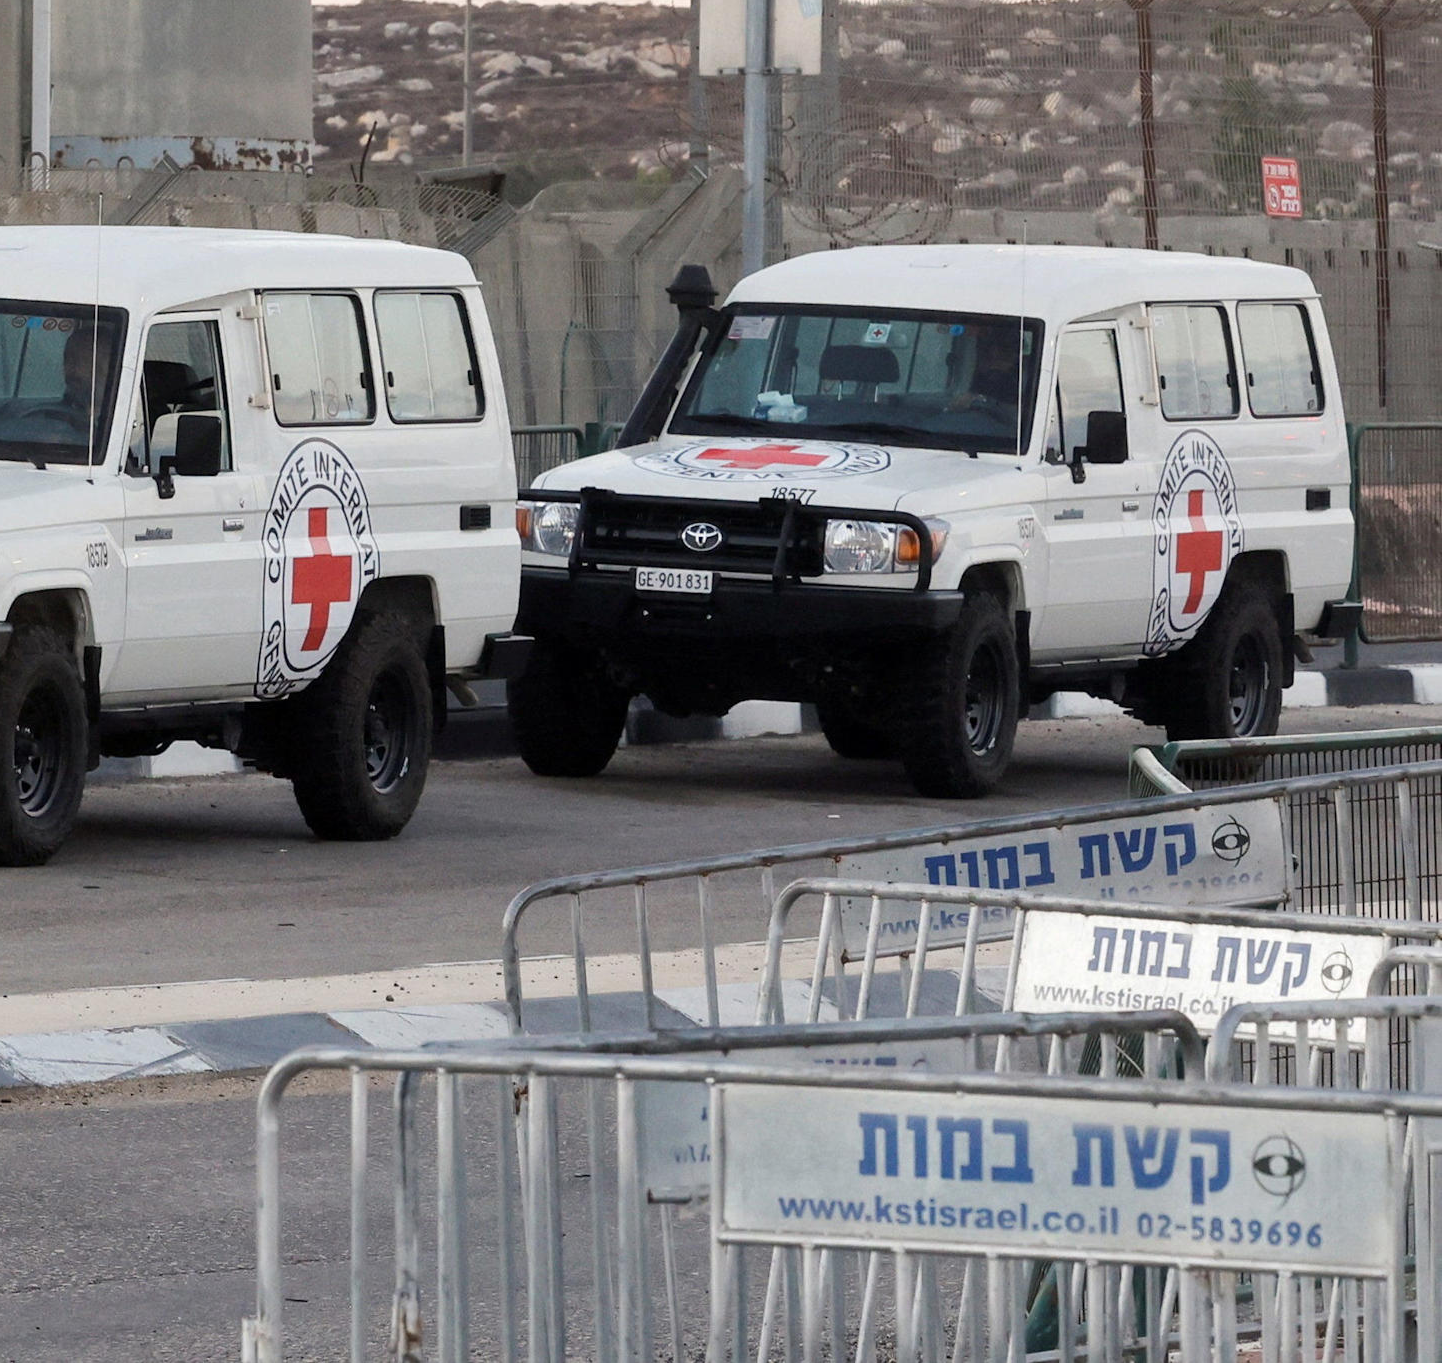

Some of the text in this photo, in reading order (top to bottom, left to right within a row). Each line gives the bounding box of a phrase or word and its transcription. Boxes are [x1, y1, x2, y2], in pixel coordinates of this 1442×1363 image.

[267, 456, 310, 584] COMITE
[771, 486, 817, 506] 18577
[1156, 445, 1189, 556] COMITE
[85, 542, 109, 569] 18579
[1079, 823, 1197, 880] קשת
[1088, 926, 1312, 996] קשת במות
[858, 1112, 1232, 1205] קשת במות
[778, 1195, 1323, 1248] www.kstisrael.co.il 02-5839696
